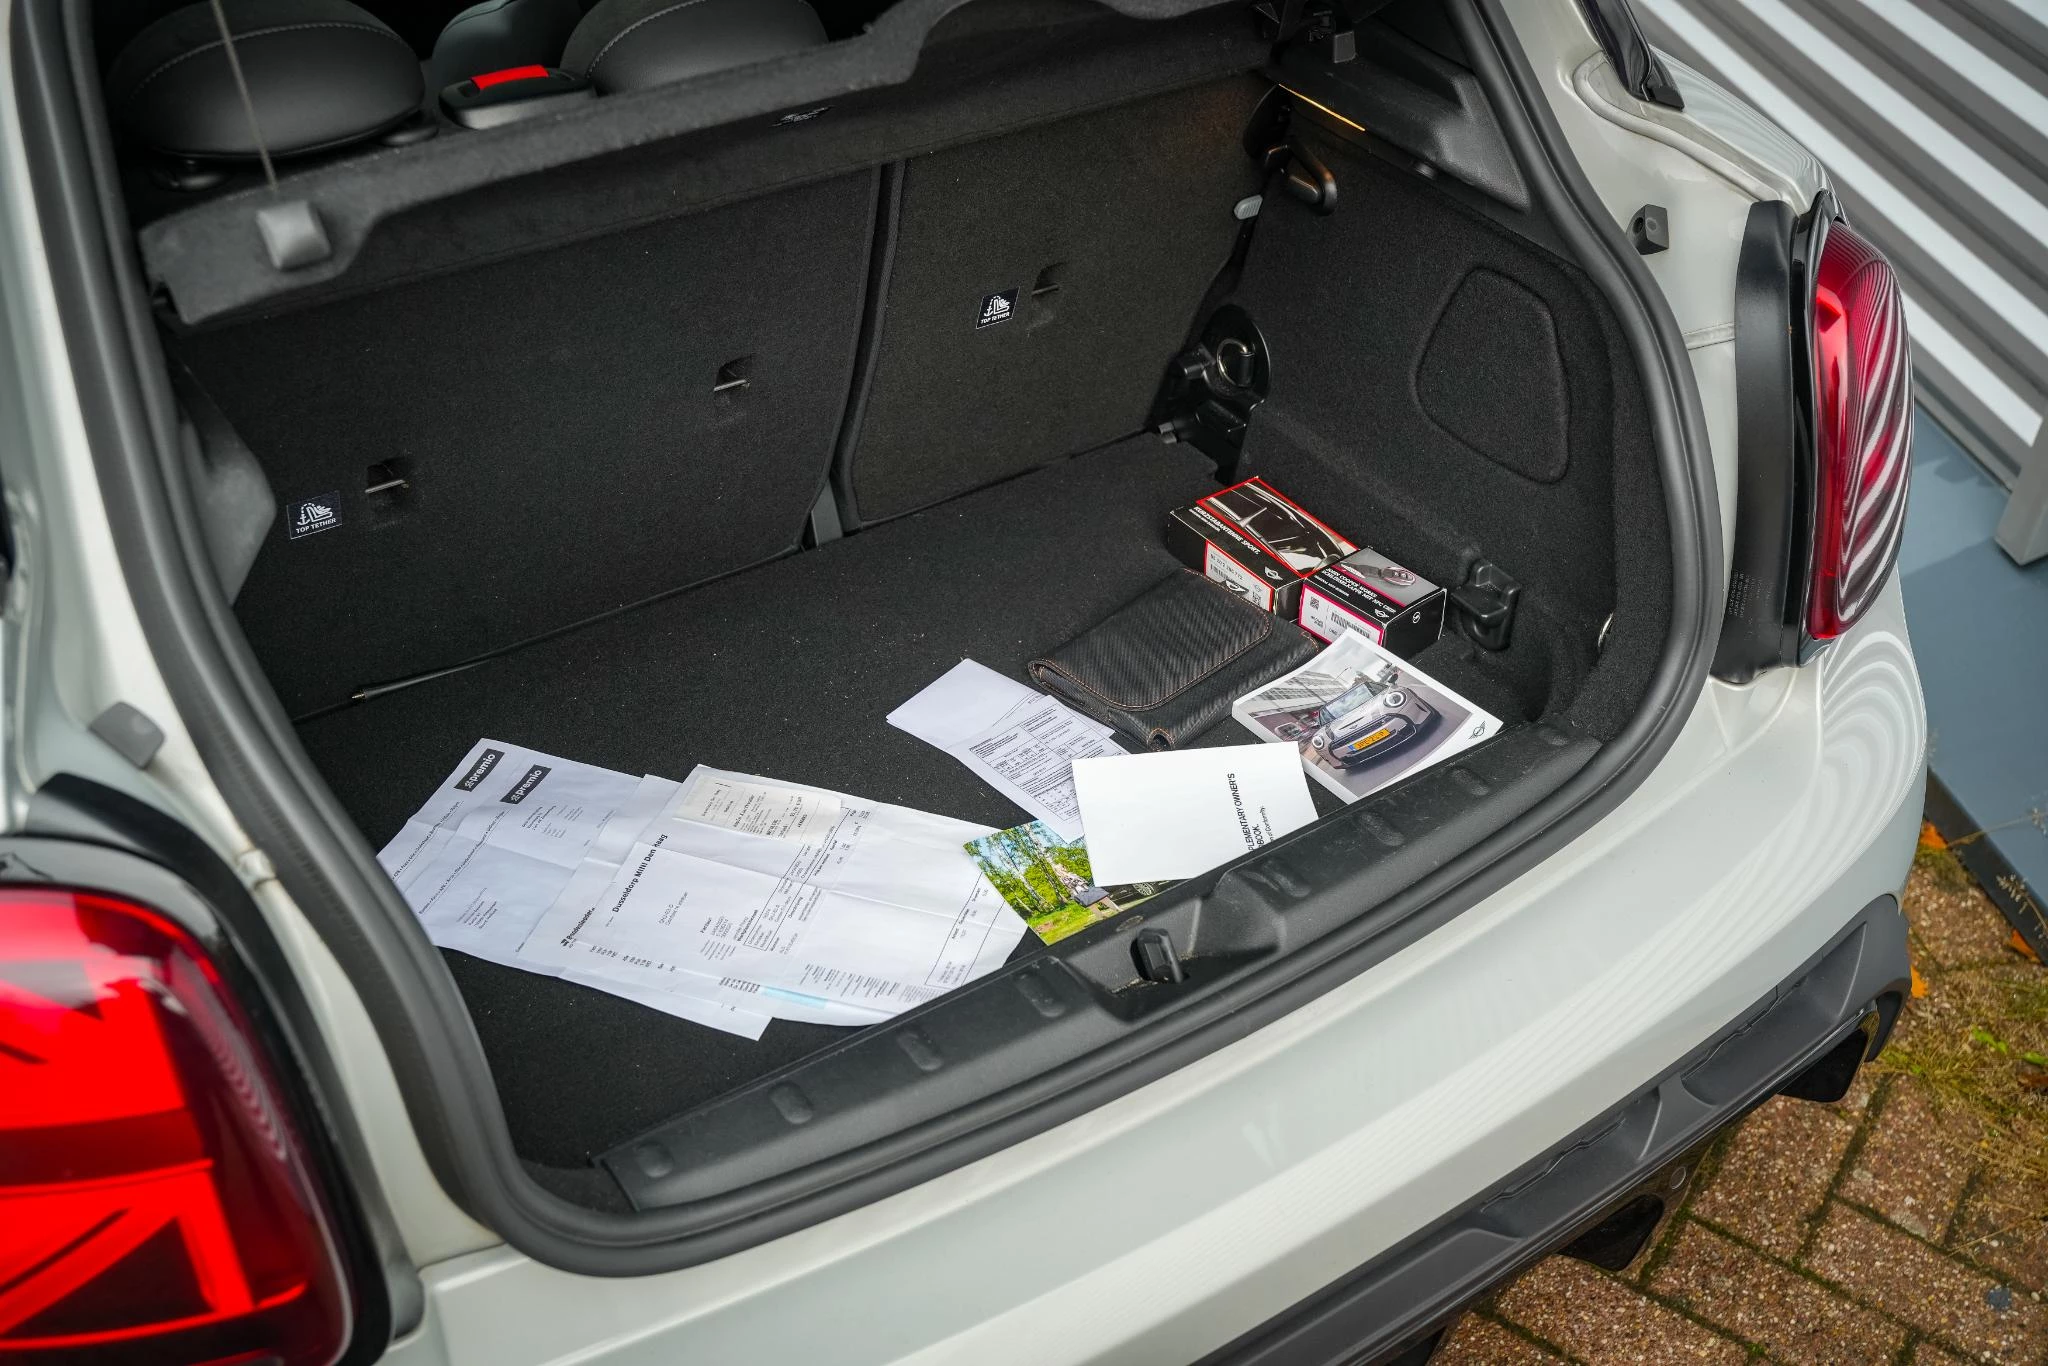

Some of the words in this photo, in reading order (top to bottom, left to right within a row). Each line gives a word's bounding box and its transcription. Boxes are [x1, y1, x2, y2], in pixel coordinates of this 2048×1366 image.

[295, 525, 310, 534] TOP
[310, 517, 337, 530] TETHER
[471, 753, 496, 782] premio
[516, 769, 543, 796] premio
[1227, 773, 1242, 807] OWNER'S
[612, 876, 639, 913] Dusseldorp
[644, 848, 657, 862] Den
